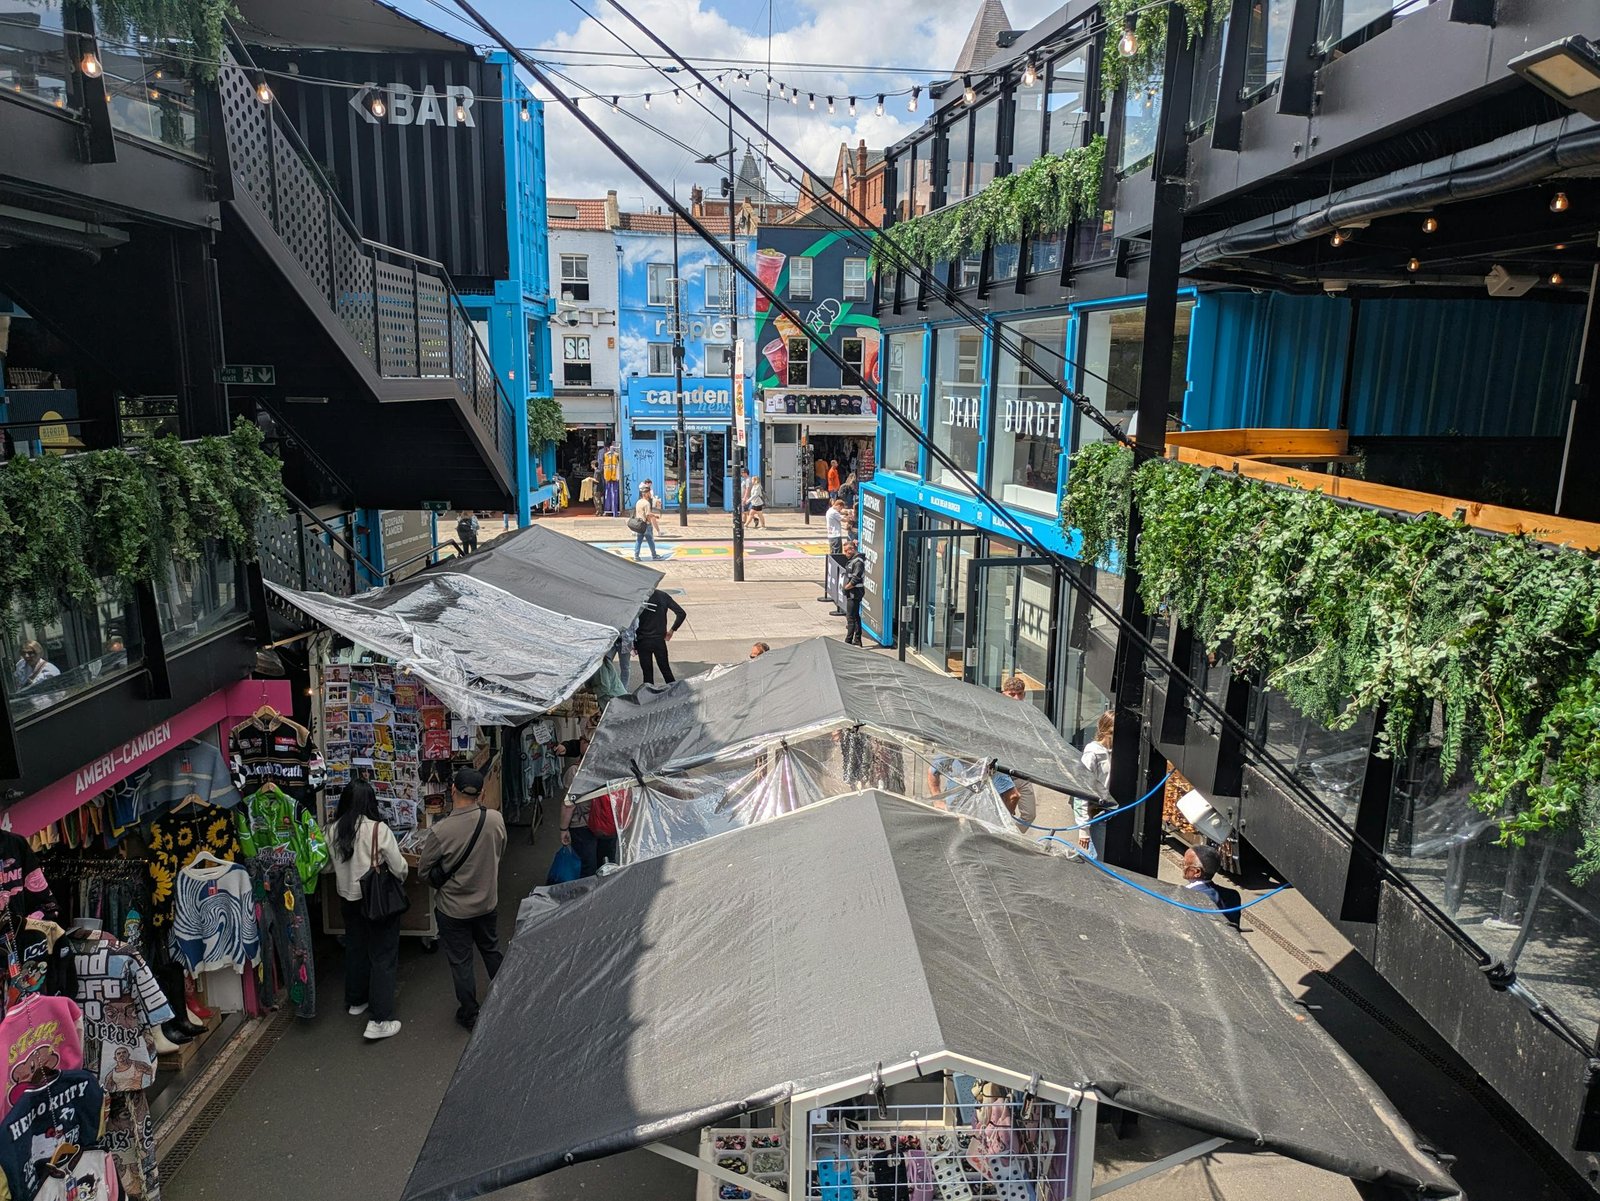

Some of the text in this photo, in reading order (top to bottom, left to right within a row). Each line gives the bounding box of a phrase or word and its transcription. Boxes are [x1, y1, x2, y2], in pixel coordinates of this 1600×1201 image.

[387, 82, 476, 127] BAR
[646, 385, 729, 405] camden
[948, 397, 979, 429] BEAR
[863, 493, 881, 512] BOXPARK
[384, 514, 405, 528] BOXPARK
[385, 524, 403, 537] CAMDEN
[75, 722, 171, 795] AMERI-CAMDEN
[273, 763, 303, 778] Death
[9, 1101, 47, 1141] HELLO
